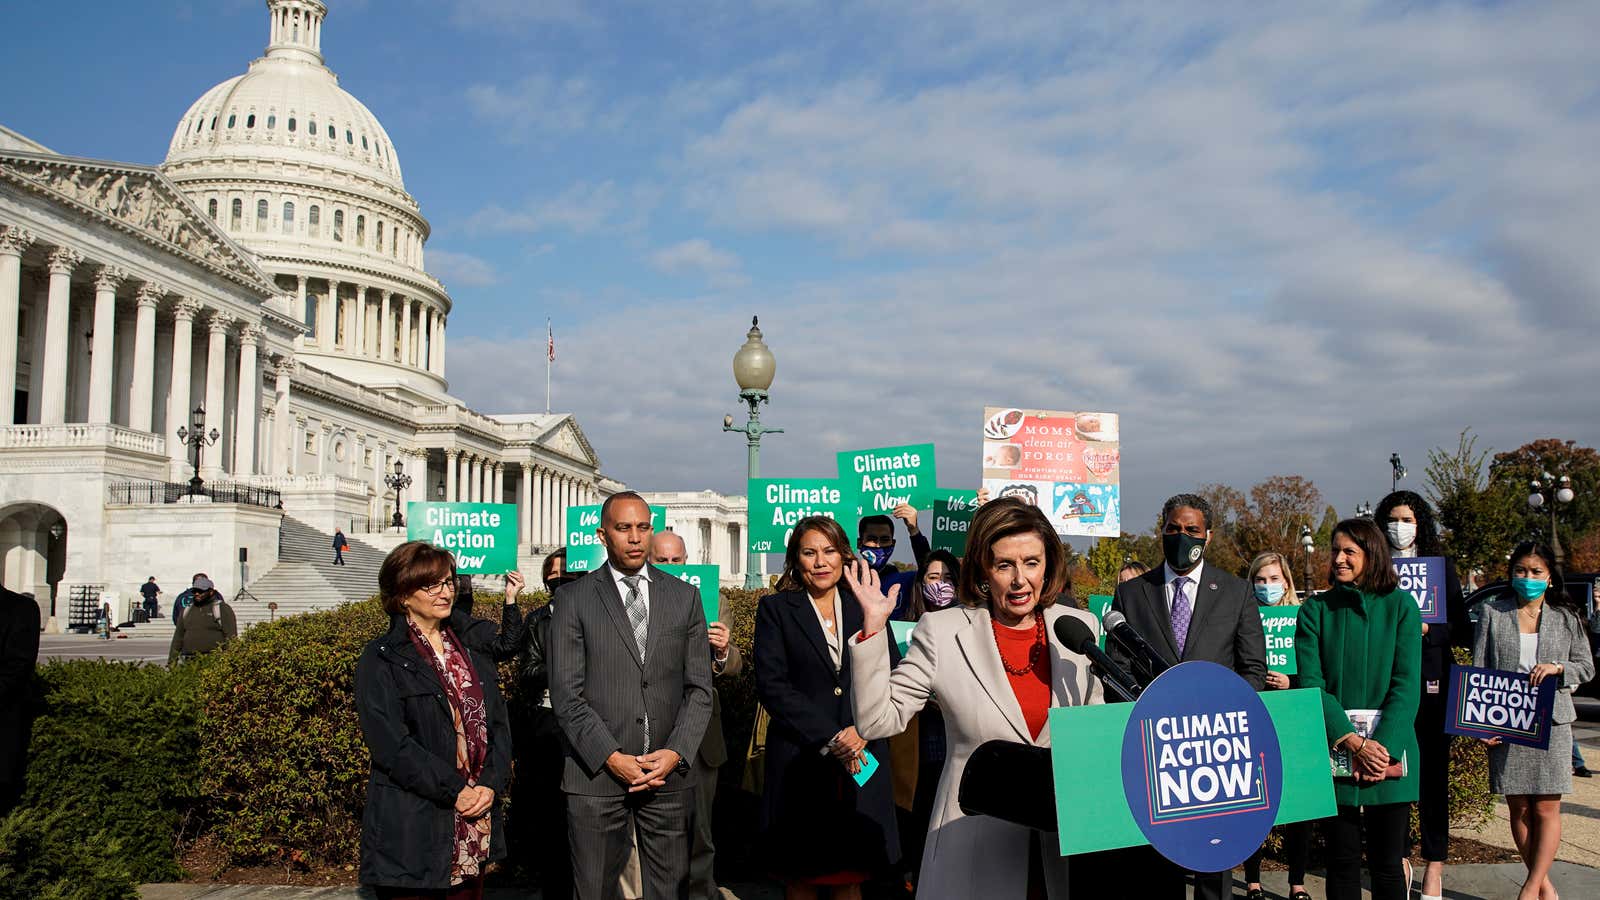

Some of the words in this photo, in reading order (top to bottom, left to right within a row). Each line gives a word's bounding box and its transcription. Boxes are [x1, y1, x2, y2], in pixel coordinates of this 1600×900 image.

[1025, 426, 1072, 436] MOMS
[1024, 436, 1053, 447] clean
[1057, 438, 1073, 448] air
[853, 452, 921, 473] Climate
[1024, 452, 1073, 461] FORCE
[862, 472, 918, 493] Action
[766, 484, 840, 504] Climate
[873, 492, 911, 511] Now
[947, 496, 966, 512] We
[426, 507, 500, 528] Climate
[579, 511, 600, 526] We
[936, 516, 971, 532] Clea
[432, 528, 495, 548] Action
[570, 532, 601, 547] Clea
[757, 541, 772, 551] LCV
[574, 560, 588, 569] LCV
[1467, 688, 1537, 710] ACTION
[1465, 701, 1536, 730] NOW
[1156, 711, 1249, 741] CLIMATE
[1159, 736, 1251, 768] ACTION
[1159, 762, 1252, 806] NOW
